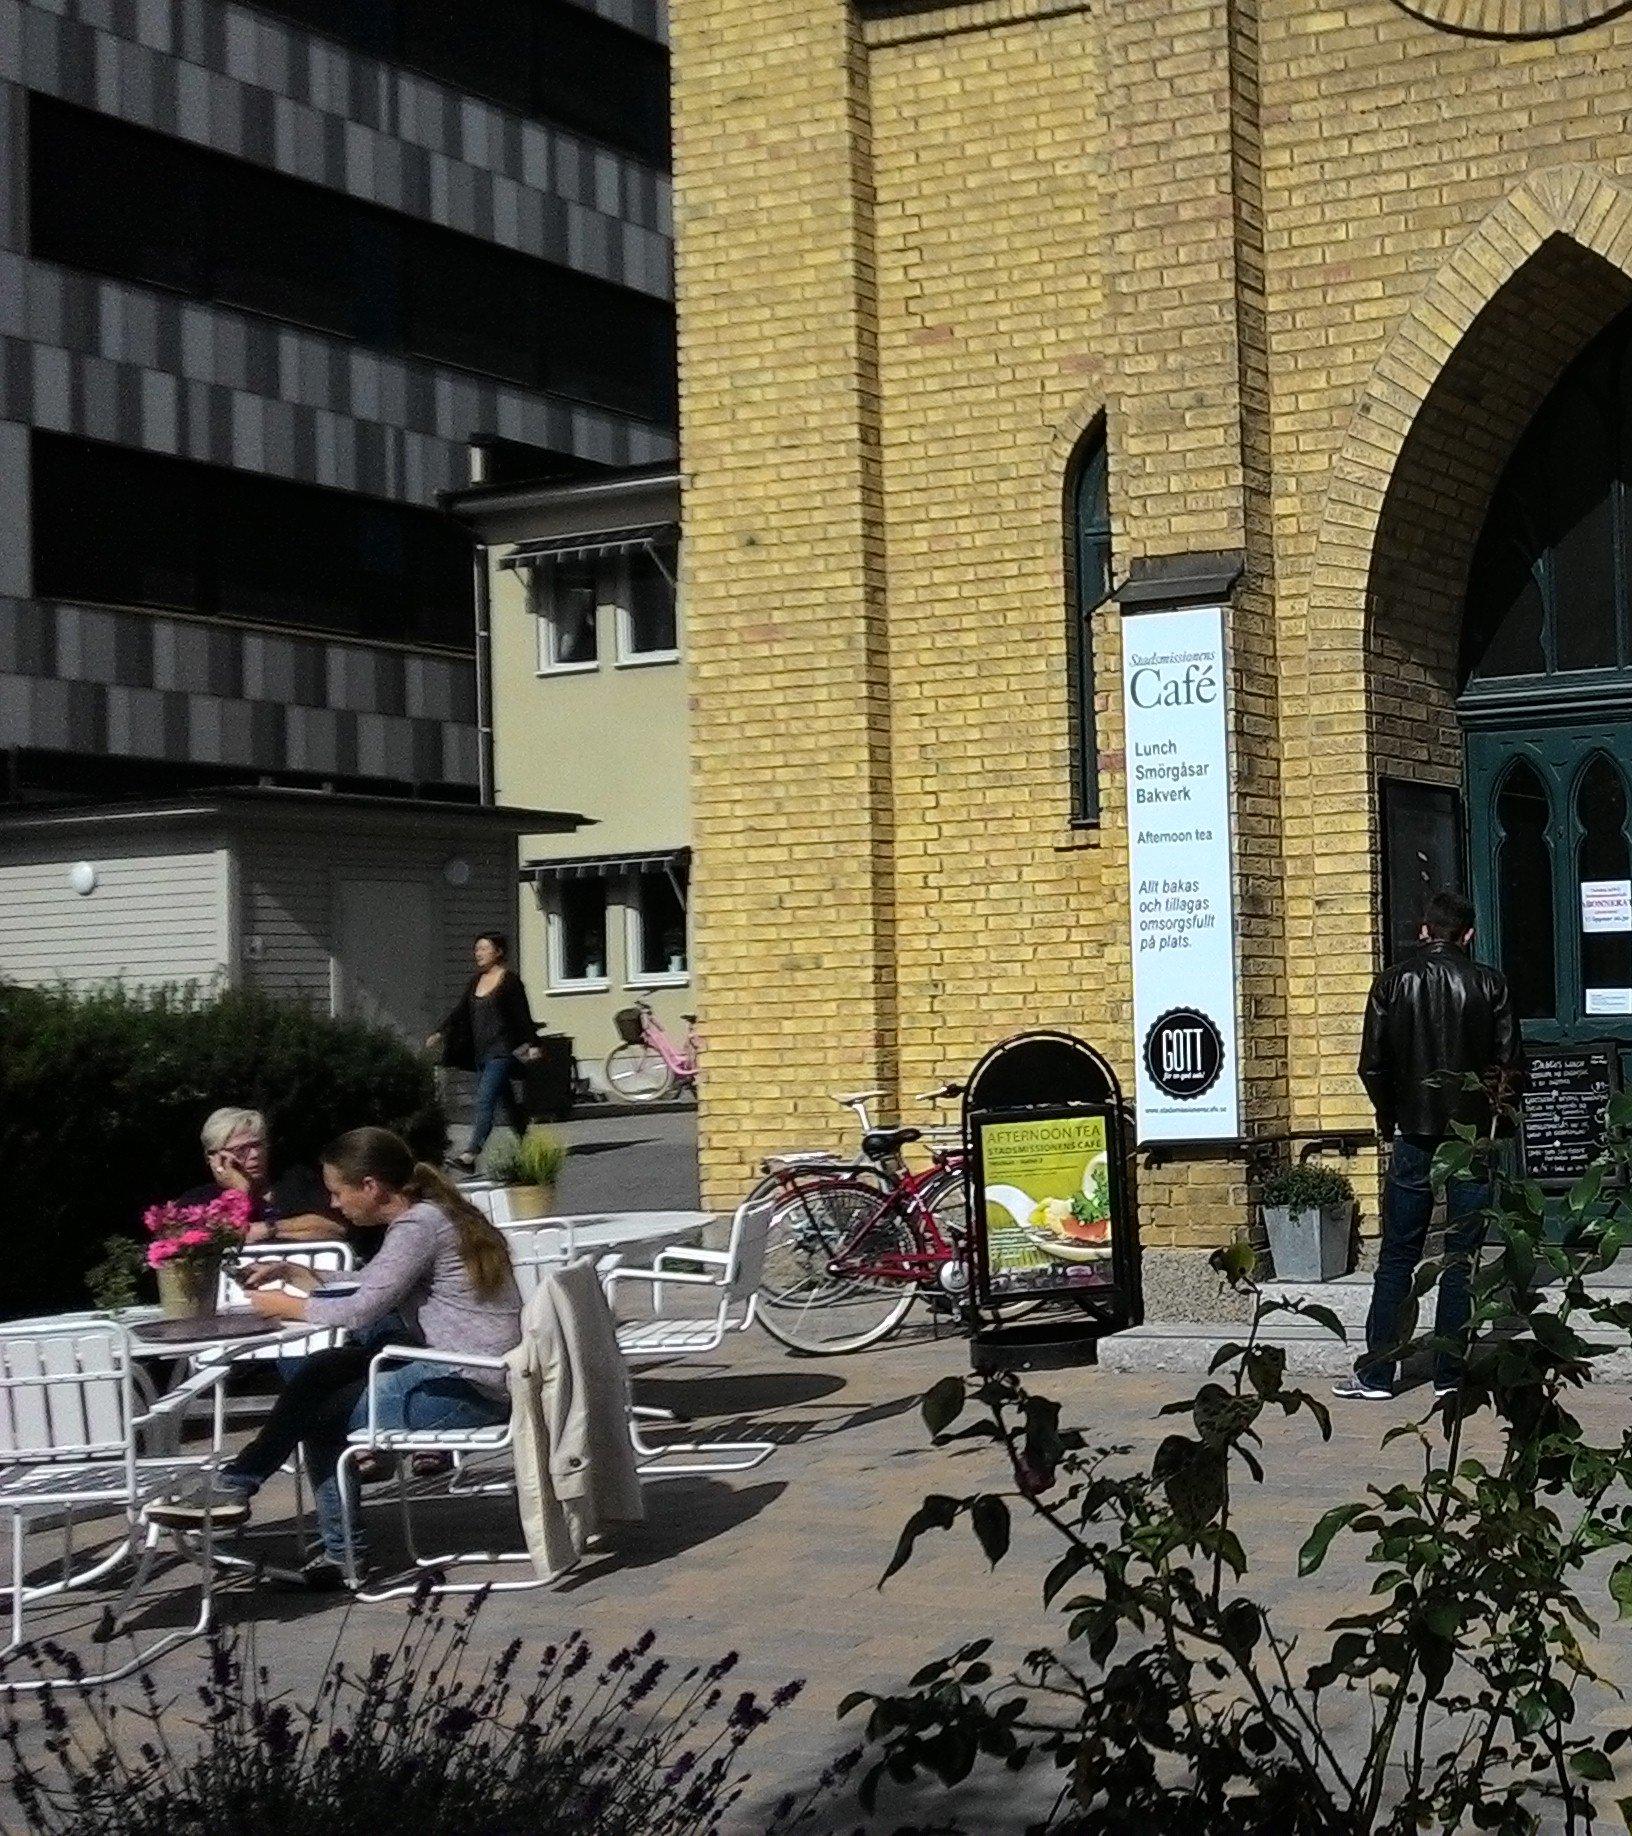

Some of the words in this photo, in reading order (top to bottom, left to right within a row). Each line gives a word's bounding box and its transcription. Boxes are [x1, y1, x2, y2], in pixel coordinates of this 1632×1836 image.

[1129, 650, 1216, 667] Stadsmissionens
[1130, 664, 1217, 708] Café
[1135, 739, 1177, 757] Lunch
[1135, 762, 1210, 783] Smörgåsar
[1136, 786, 1191, 804] Bakverk
[1137, 829, 1192, 845] Afternoon
[1195, 828, 1213, 842] tea
[1139, 880, 1159, 895] Allt
[1162, 878, 1199, 893] bakas
[1139, 898, 1161, 914] och
[1165, 897, 1210, 915] tillagas
[1140, 914, 1216, 934] omsorgsfullt
[1140, 936, 1156, 951] på
[1162, 1028, 1204, 1072] GOTT
[987, 1128, 1072, 1144] AFTERNOON
[1074, 1125, 1101, 1138] TEA
